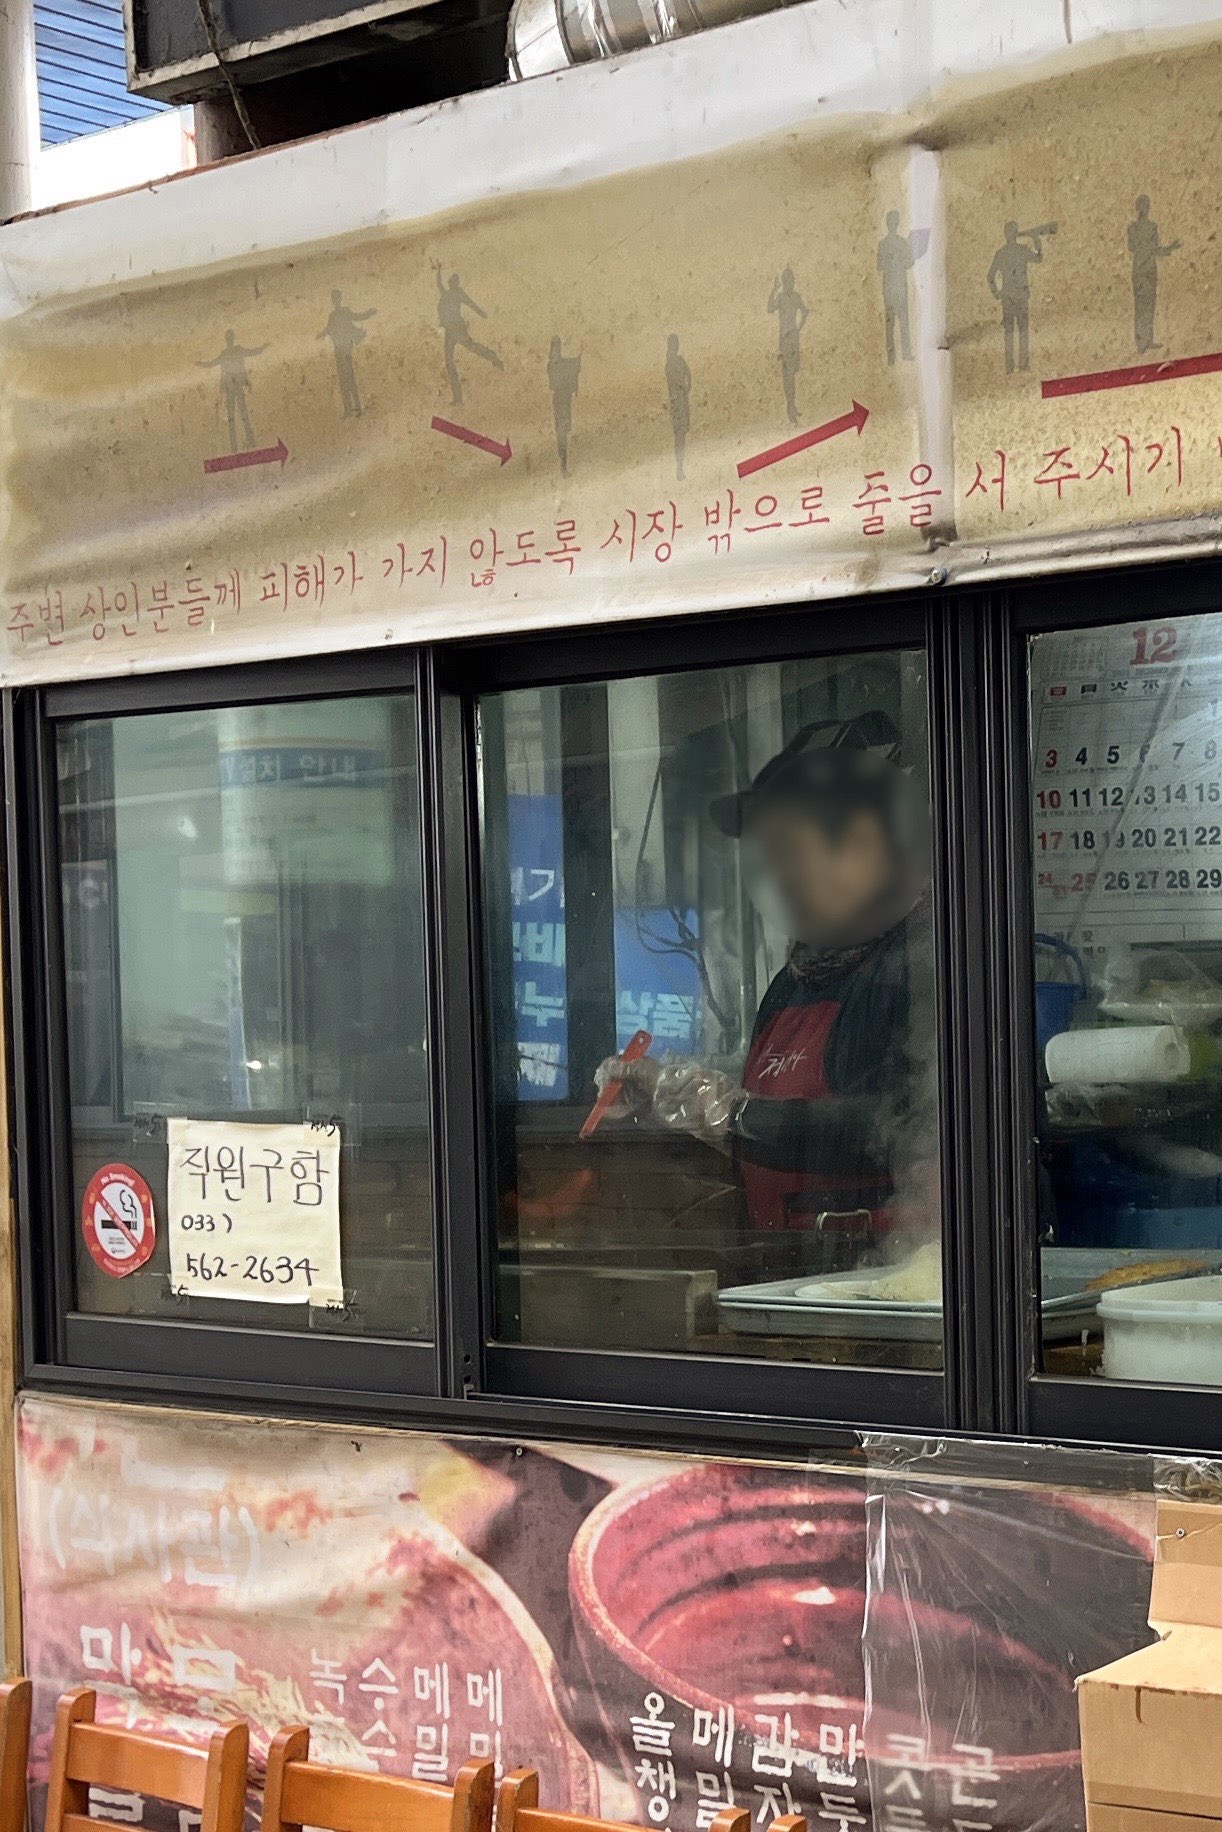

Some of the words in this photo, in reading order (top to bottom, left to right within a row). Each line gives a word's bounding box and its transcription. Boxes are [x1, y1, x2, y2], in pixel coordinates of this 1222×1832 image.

[6, 591, 64, 647] 주변
[79, 569, 240, 642] 상인분들께
[260, 551, 363, 612] 피해가
[383, 535, 447, 588] 가지
[469, 518, 582, 588] 않도록
[600, 500, 683, 564] 시장
[704, 486, 830, 555] 밖으로
[852, 463, 942, 536] 줄을
[965, 449, 1006, 512] 서
[1033, 425, 1184, 499] 주시기
[1129, 625, 1178, 666] 12
[1045, 749, 1058, 769] 3
[1075, 747, 1088, 766] 4
[1106, 745, 1121, 764] 5
[1171, 742, 1186, 761] 7
[1036, 789, 1062, 809] 10
[1069, 788, 1092, 807] 11
[1100, 787, 1124, 807] 12
[1164, 783, 1188, 804] 14
[1197, 782, 1221, 802] 15
[1037, 830, 1063, 850] 17
[1070, 830, 1095, 849] 18
[1131, 828, 1157, 848] 20
[1164, 826, 1188, 846] 21
[1195, 825, 1221, 846] 22
[1104, 871, 1130, 891] 26
[1136, 870, 1160, 890] 27
[1166, 869, 1190, 889] 28
[1196, 868, 1222, 889] 29
[179, 1146, 331, 1206] 직원구함
[181, 1213, 233, 1234] 033)
[187, 1253, 319, 1287] 562-2634
